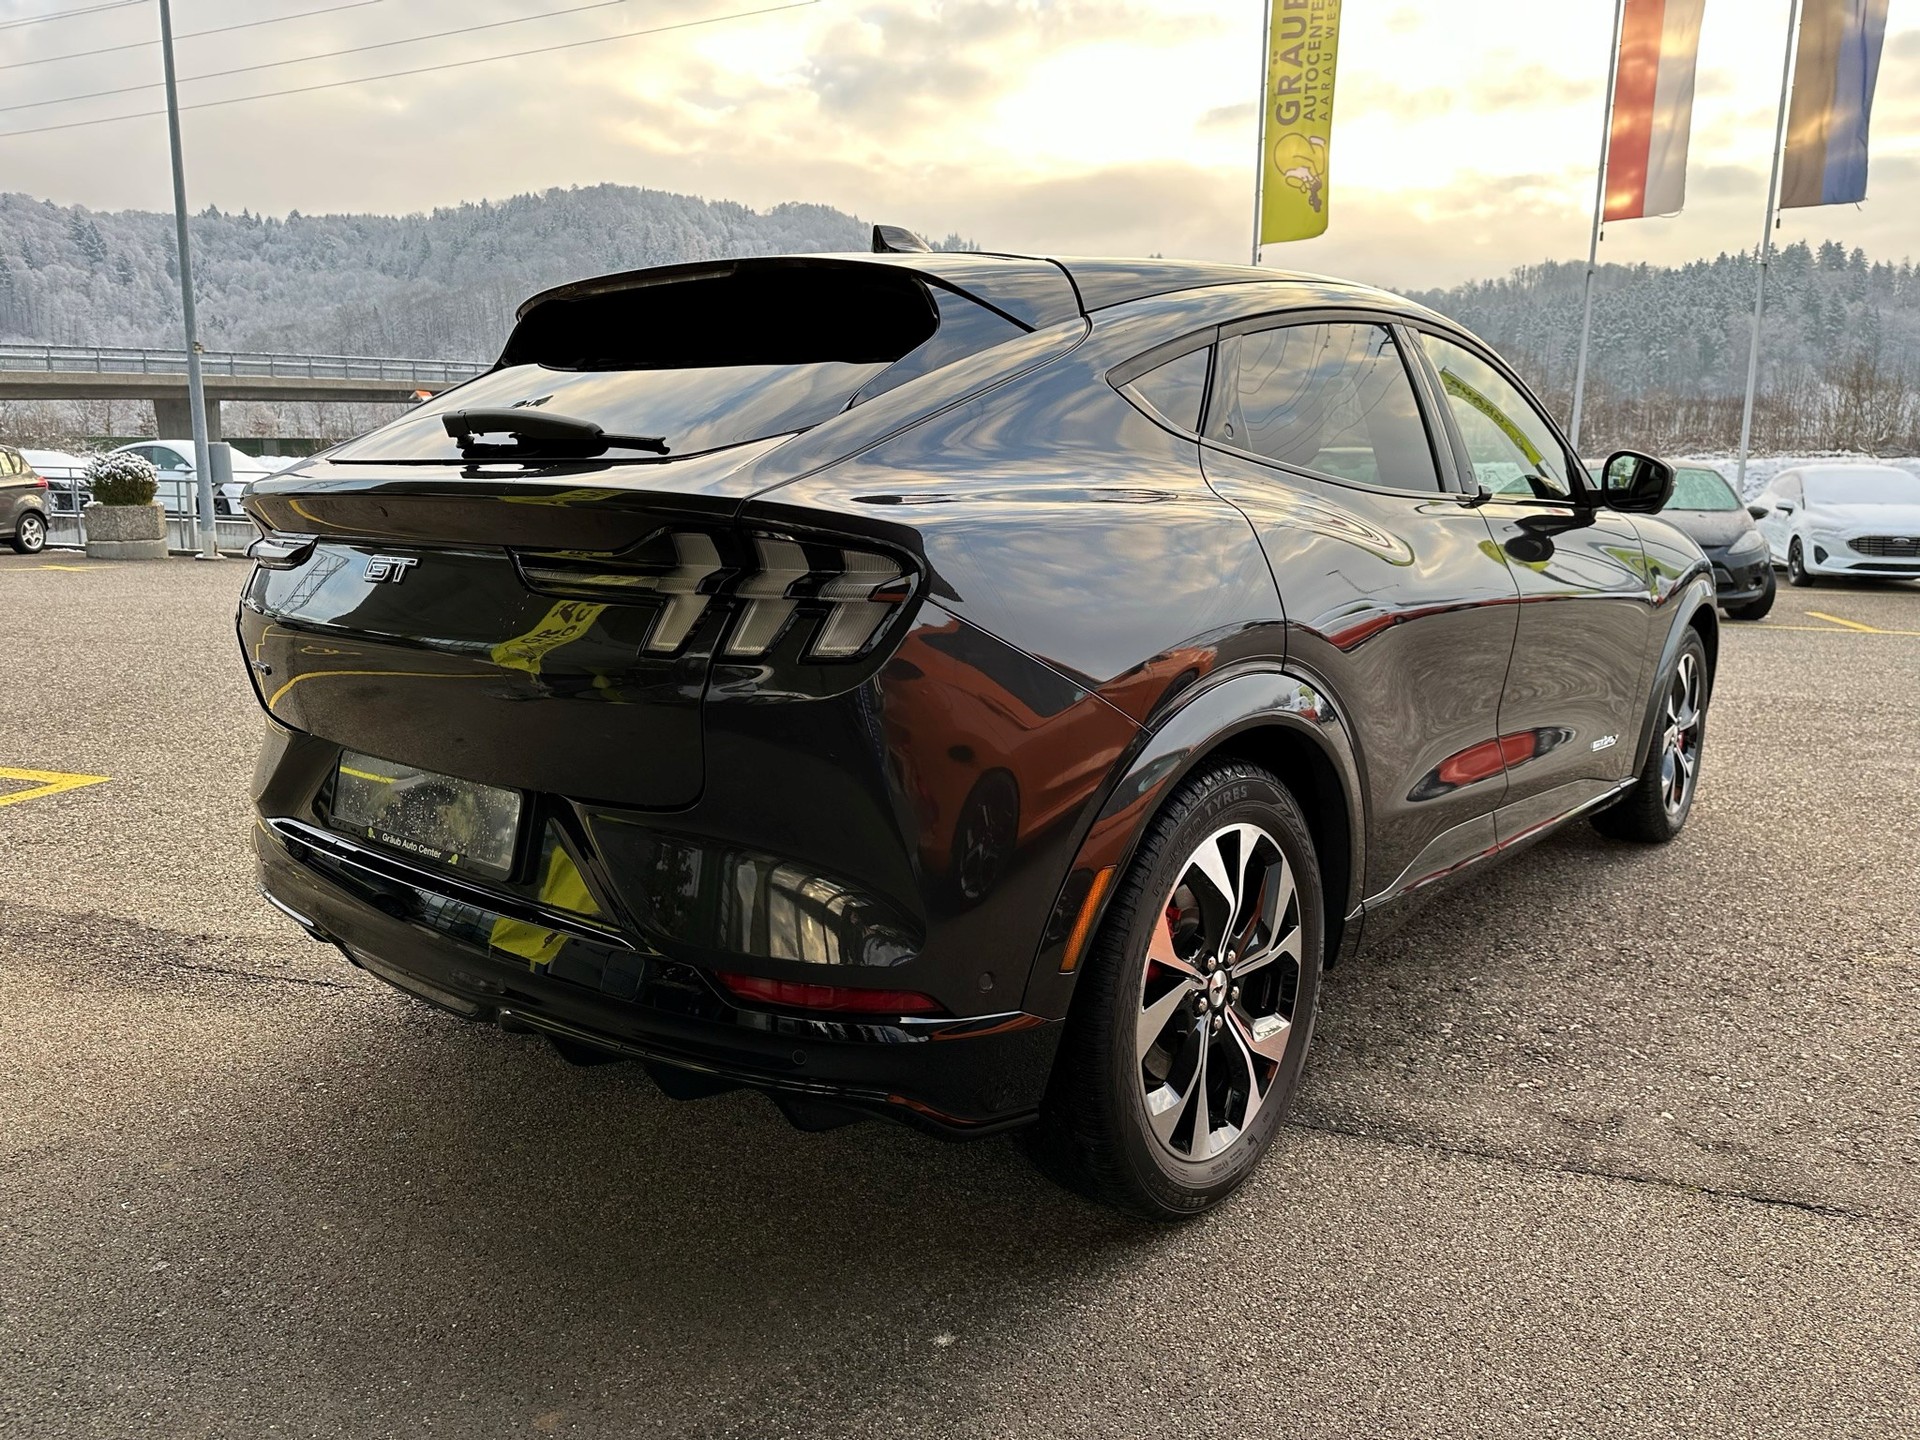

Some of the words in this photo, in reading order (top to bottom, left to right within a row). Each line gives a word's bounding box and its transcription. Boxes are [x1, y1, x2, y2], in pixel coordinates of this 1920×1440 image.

[1319, 53, 1333, 121] AARAU
[363, 554, 419, 583] GT
[1204, 785, 1249, 817] TYRES
[382, 833, 402, 846] Gräub
[402, 839, 418, 851] Auto
[418, 844, 441, 859] Center
